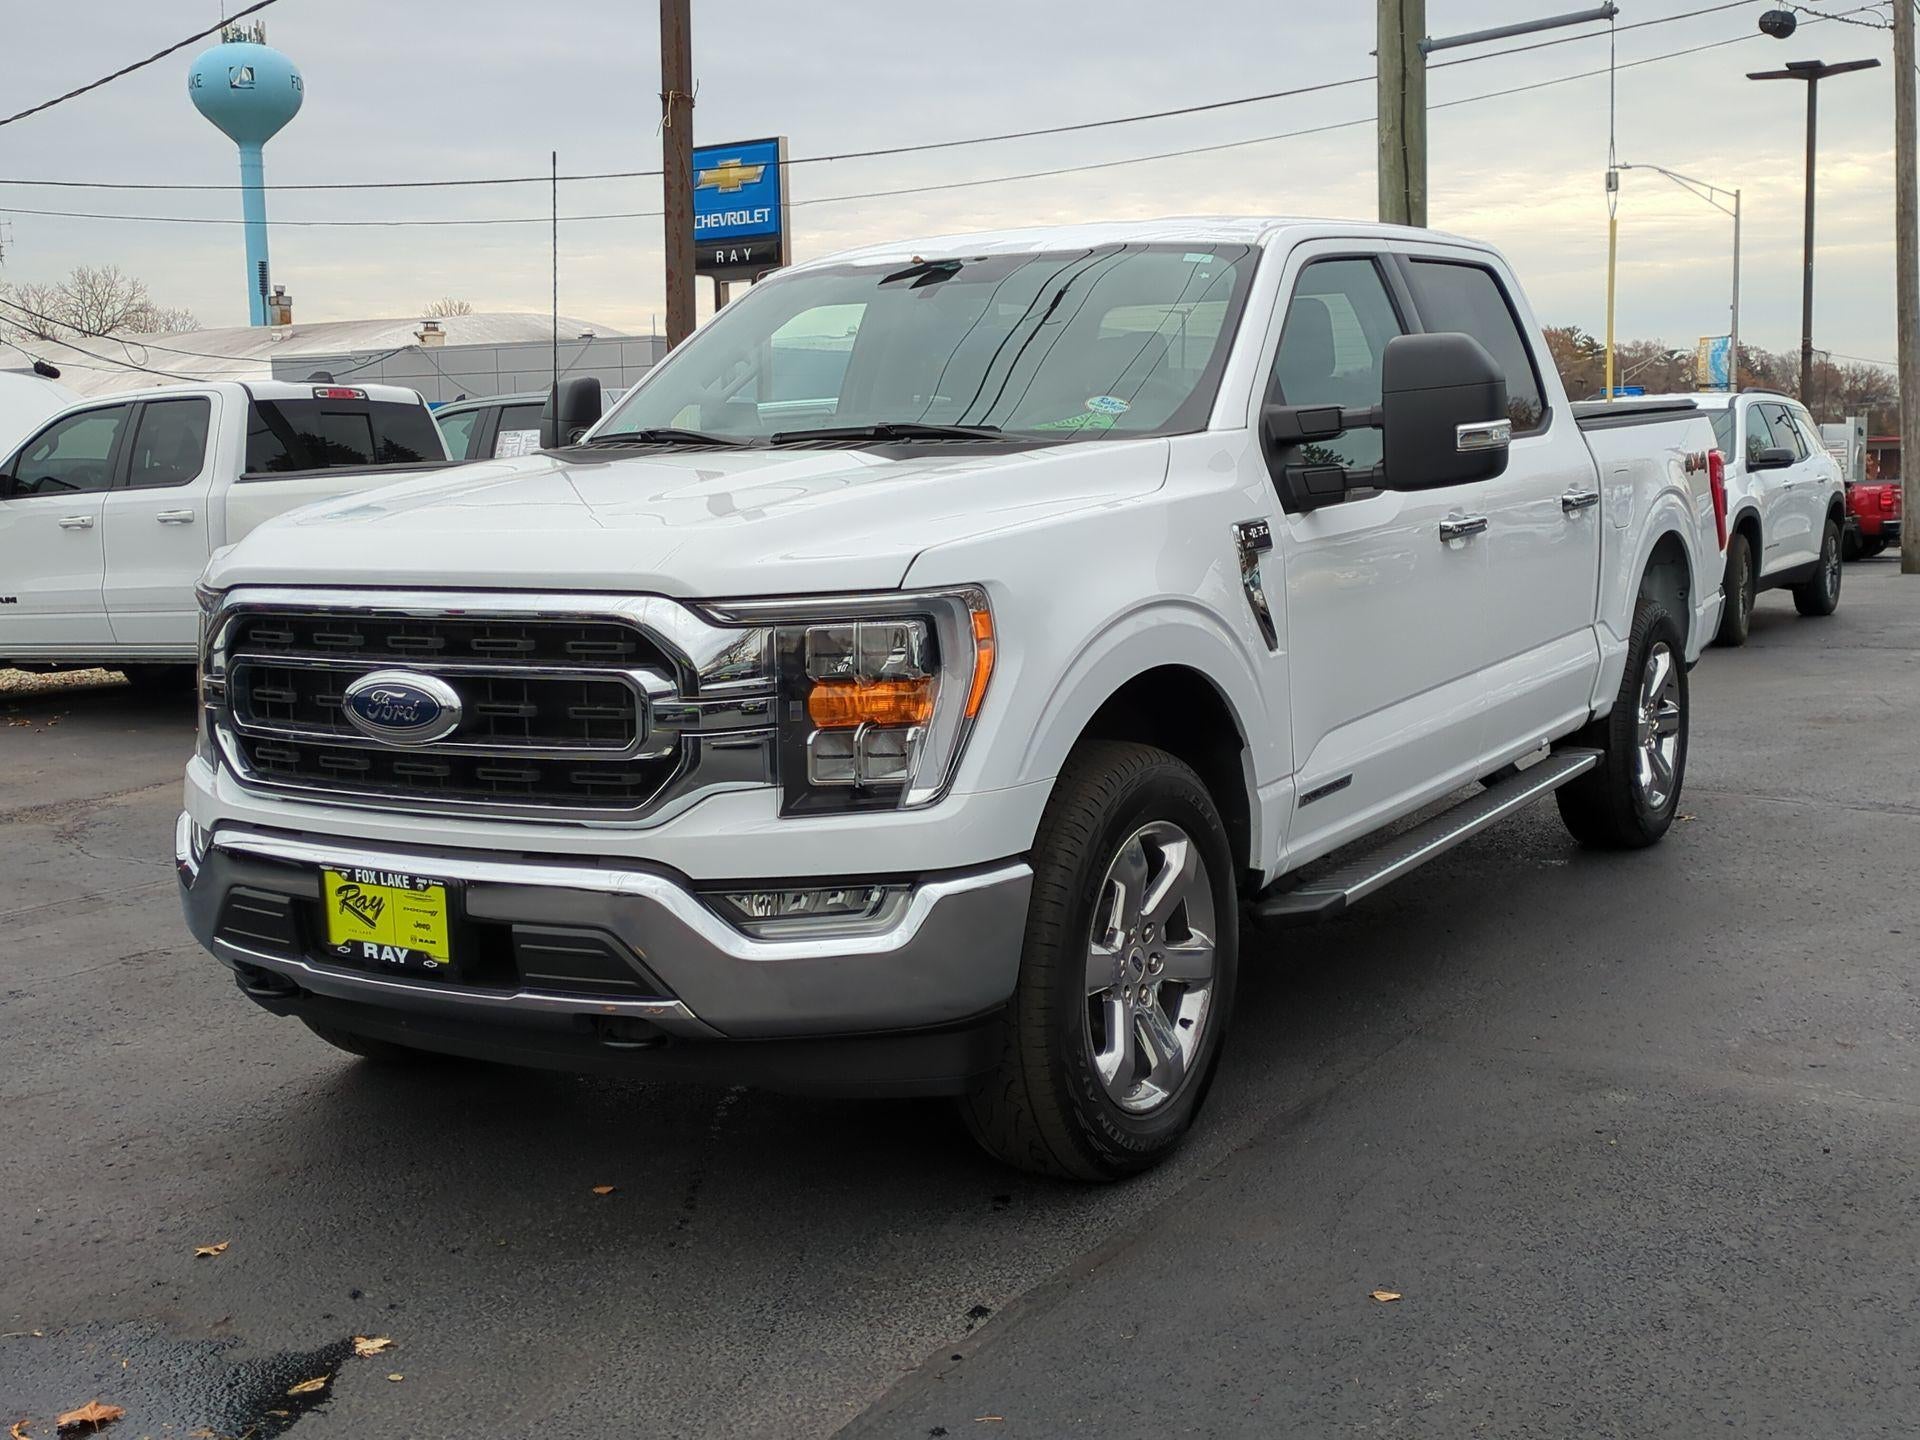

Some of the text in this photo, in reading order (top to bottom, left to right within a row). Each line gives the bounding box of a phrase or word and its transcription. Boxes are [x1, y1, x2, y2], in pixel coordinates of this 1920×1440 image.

[694, 208, 771, 229] CHEVROLET
[716, 248, 752, 263] RAY
[366, 689, 421, 721] Ford
[355, 869, 377, 885] FOX
[380, 872, 411, 888] LAKE
[335, 884, 385, 929] Ray
[363, 942, 409, 964] RAY
